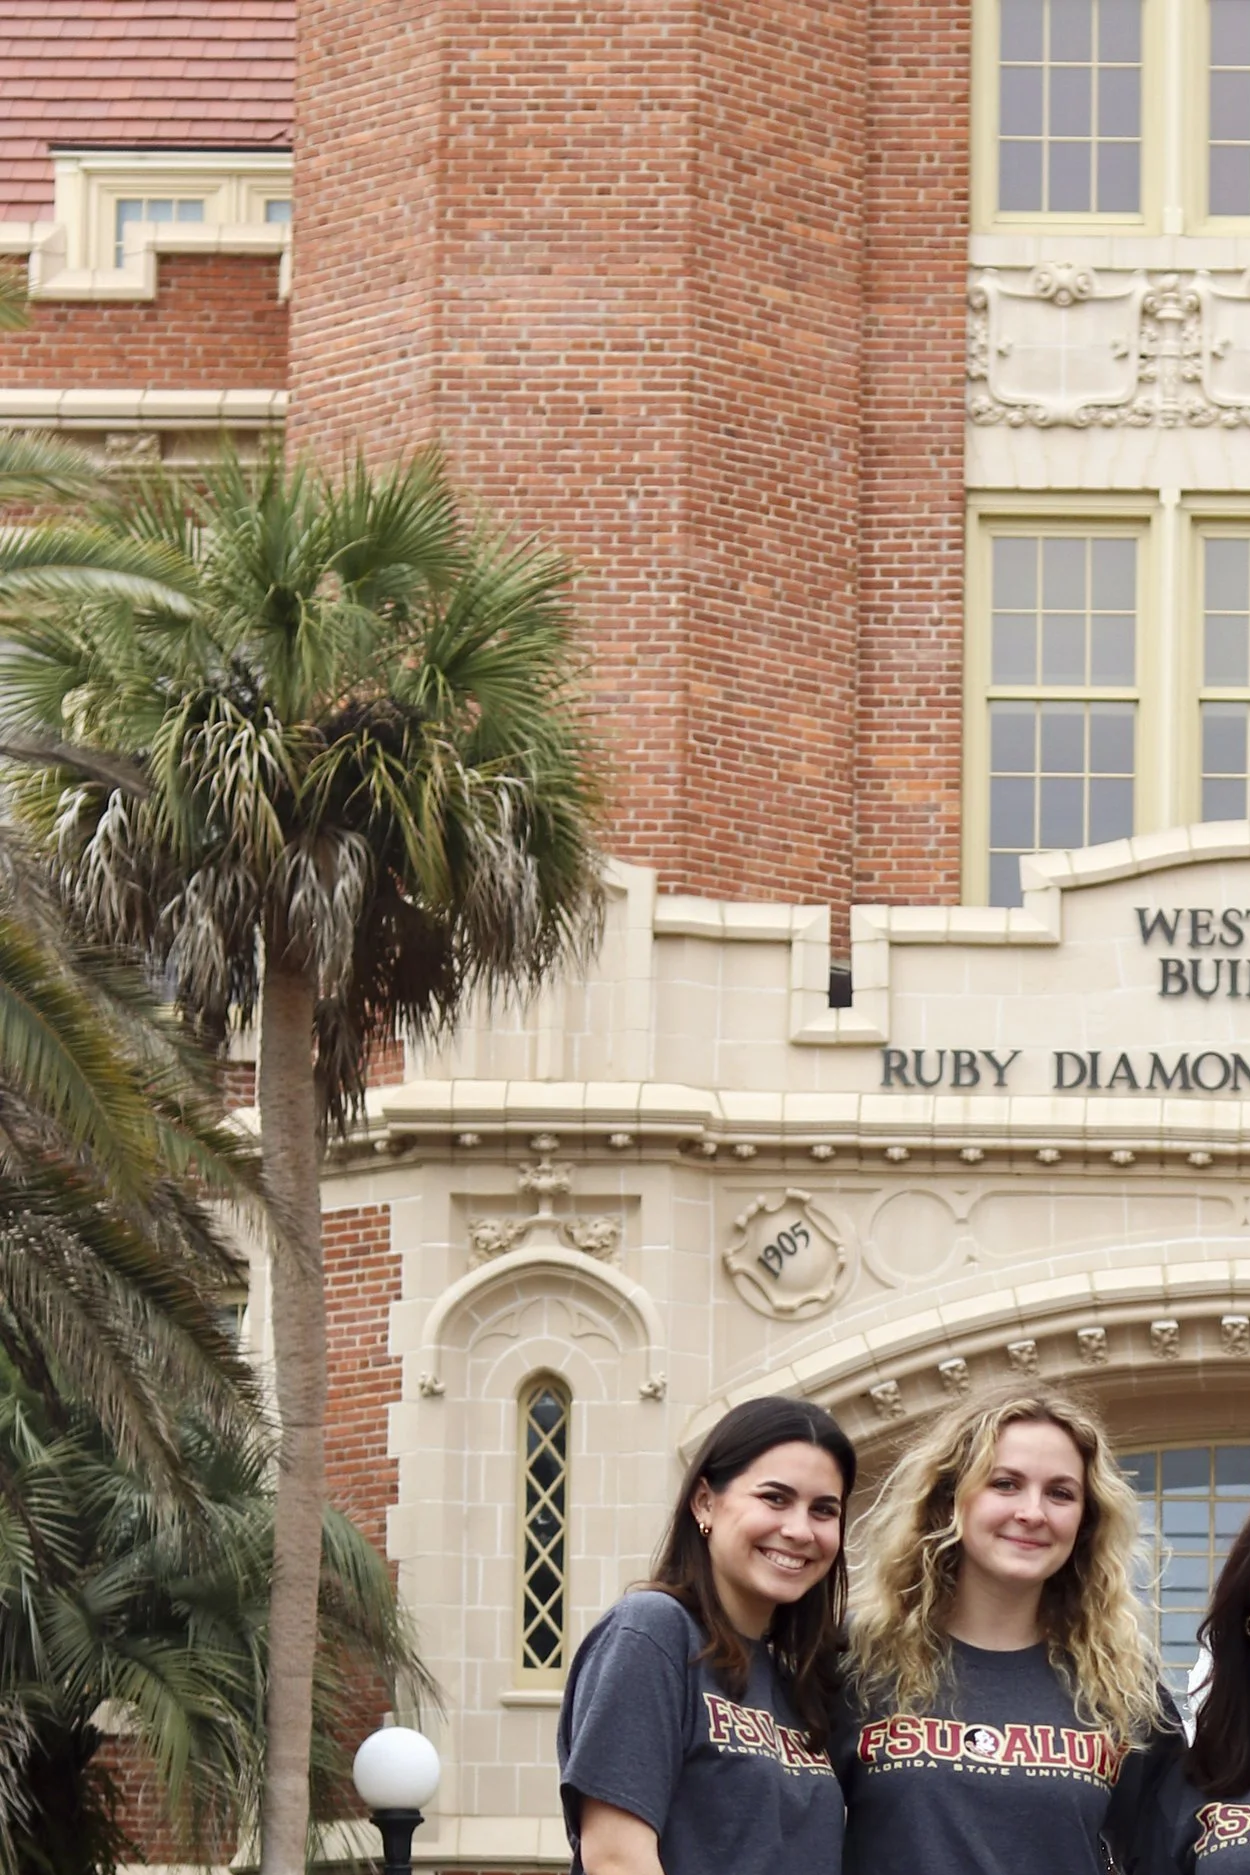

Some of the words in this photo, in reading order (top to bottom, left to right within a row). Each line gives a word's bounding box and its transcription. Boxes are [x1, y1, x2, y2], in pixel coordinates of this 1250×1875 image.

[880, 1049, 1022, 1090] RUBY
[756, 1220, 810, 1281] 1905
[703, 1692, 780, 1754] FSU
[857, 1713, 966, 1764] FSU
[997, 1723, 1131, 1787] ALUM
[867, 1759, 938, 1775] FLORIDA
[953, 1763, 1010, 1776] STATE
